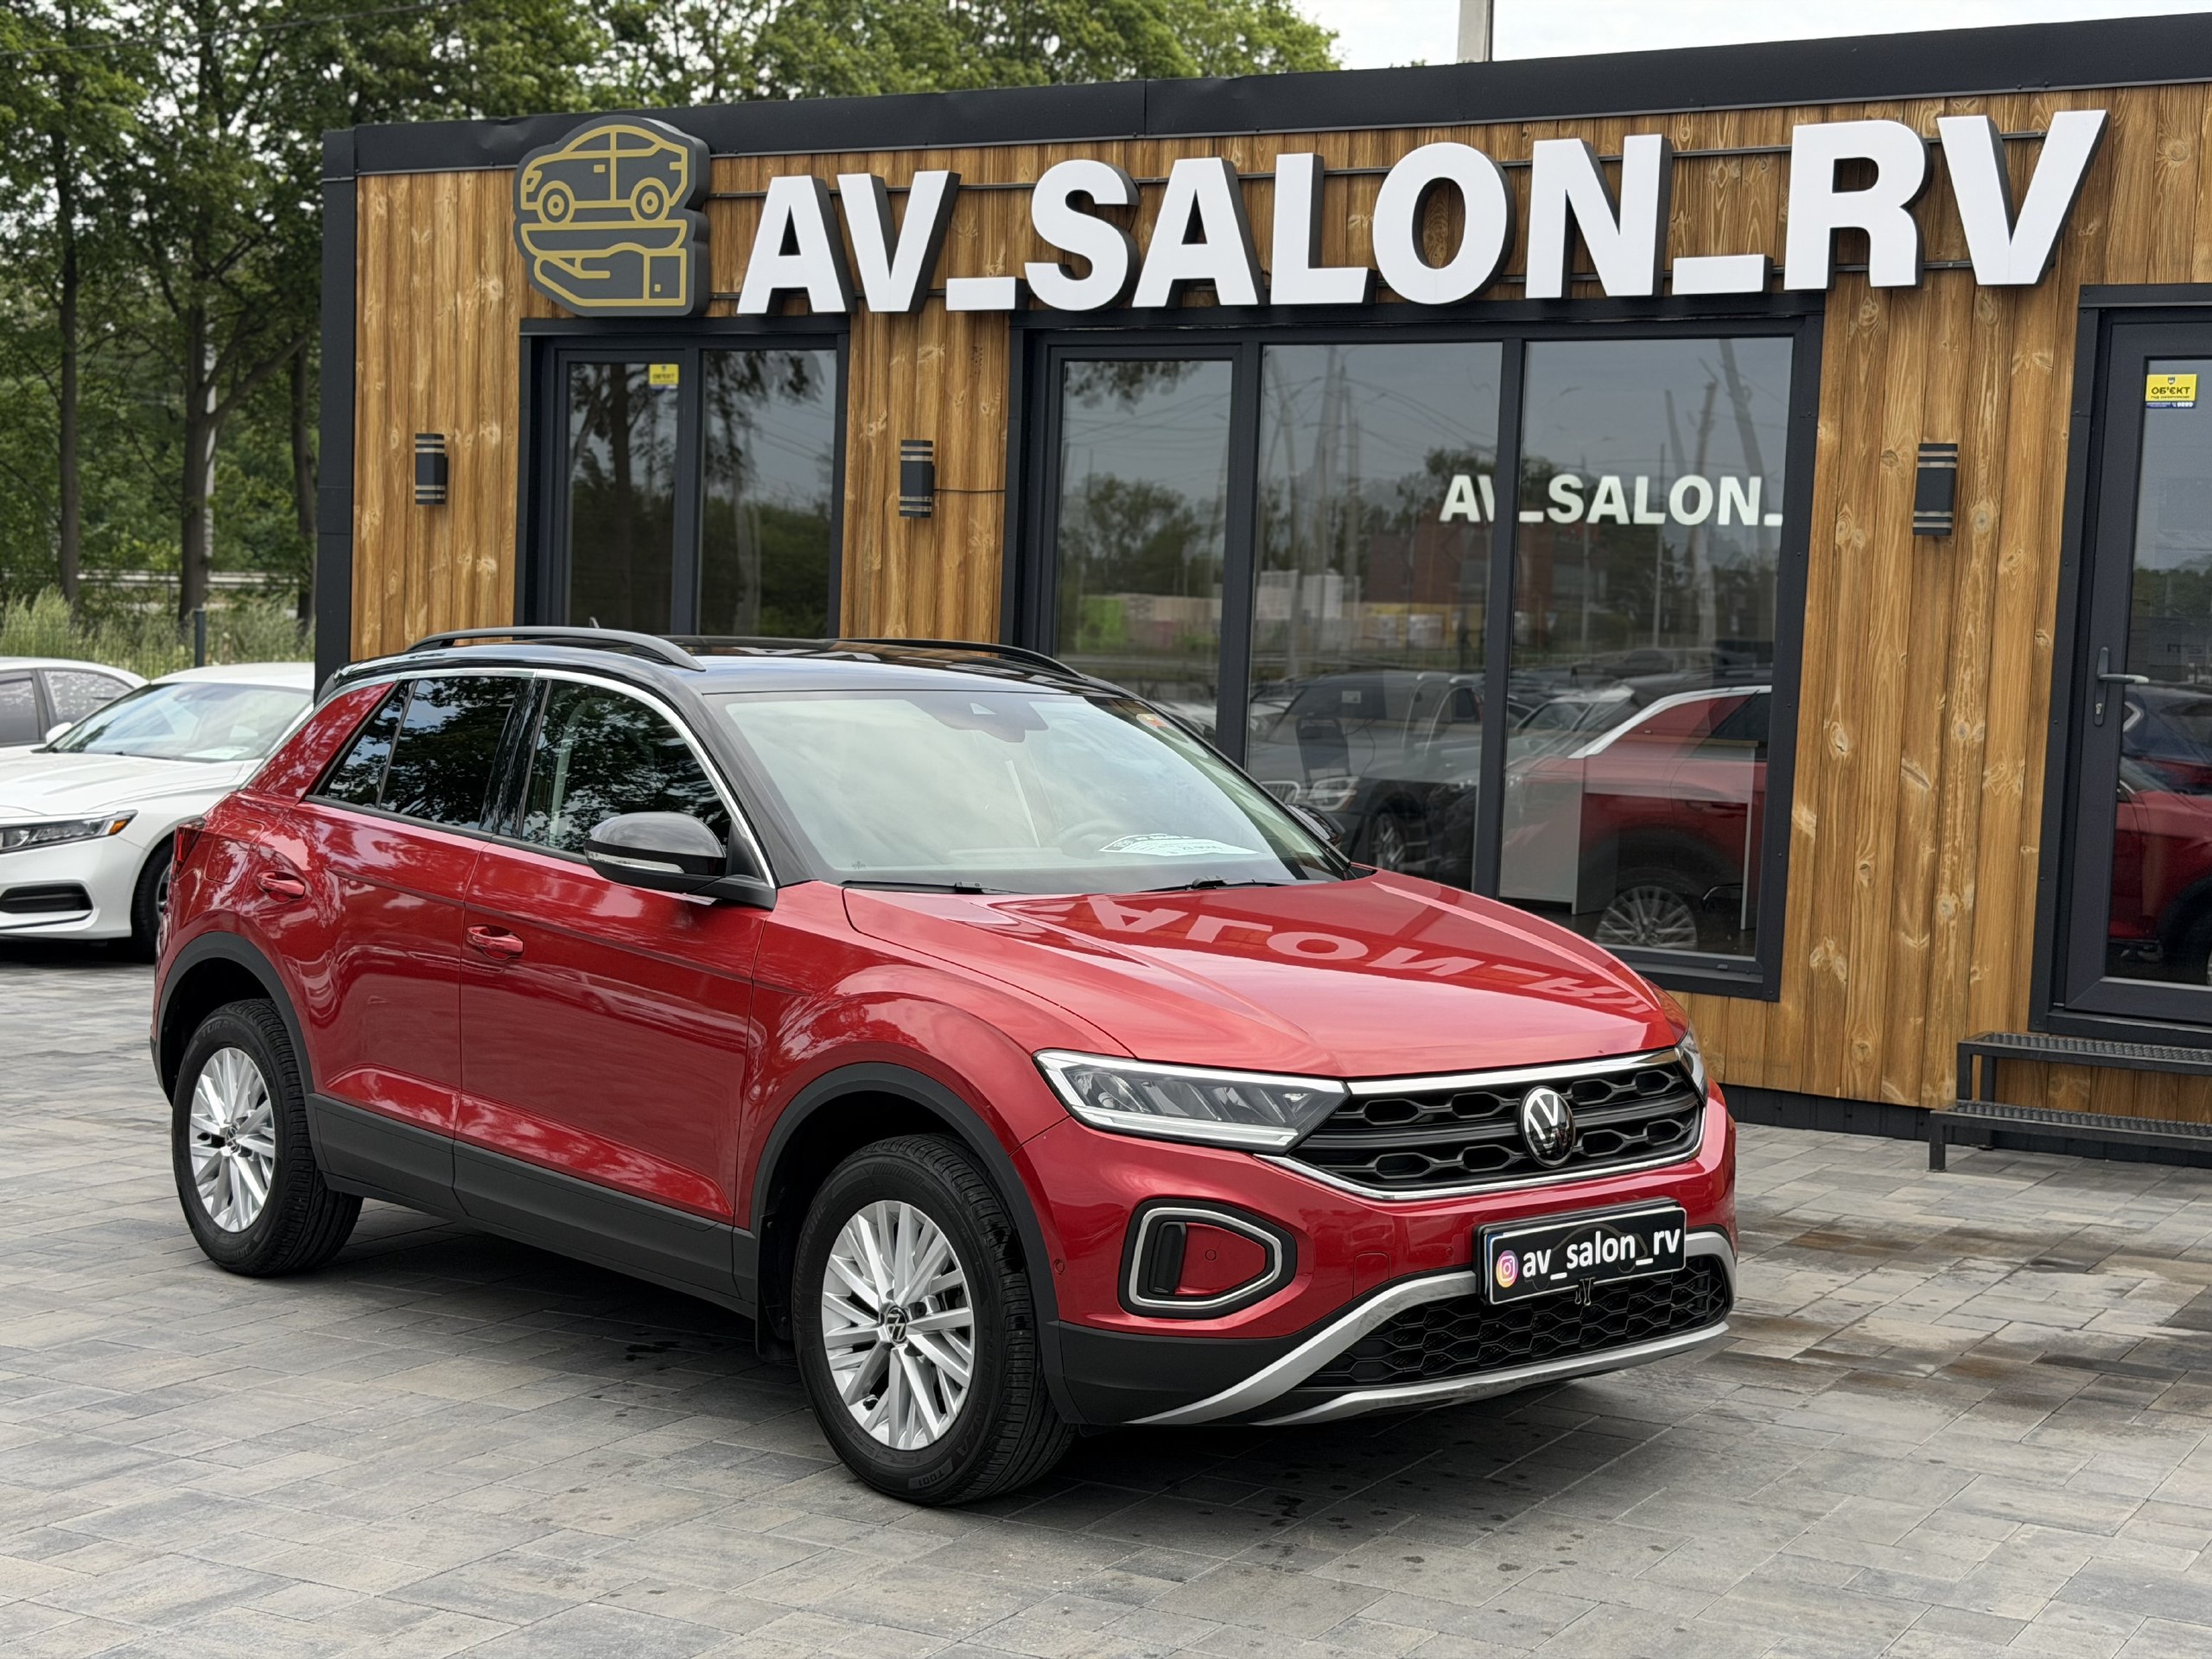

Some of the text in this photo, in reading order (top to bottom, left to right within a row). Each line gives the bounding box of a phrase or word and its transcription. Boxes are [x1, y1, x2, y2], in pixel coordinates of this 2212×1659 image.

[736, 109, 2108, 315] AV_SALON_RV
[2151, 386, 2190, 395] ОБ'ЄКТ
[1522, 1229, 1681, 1280] av_salon_rv
